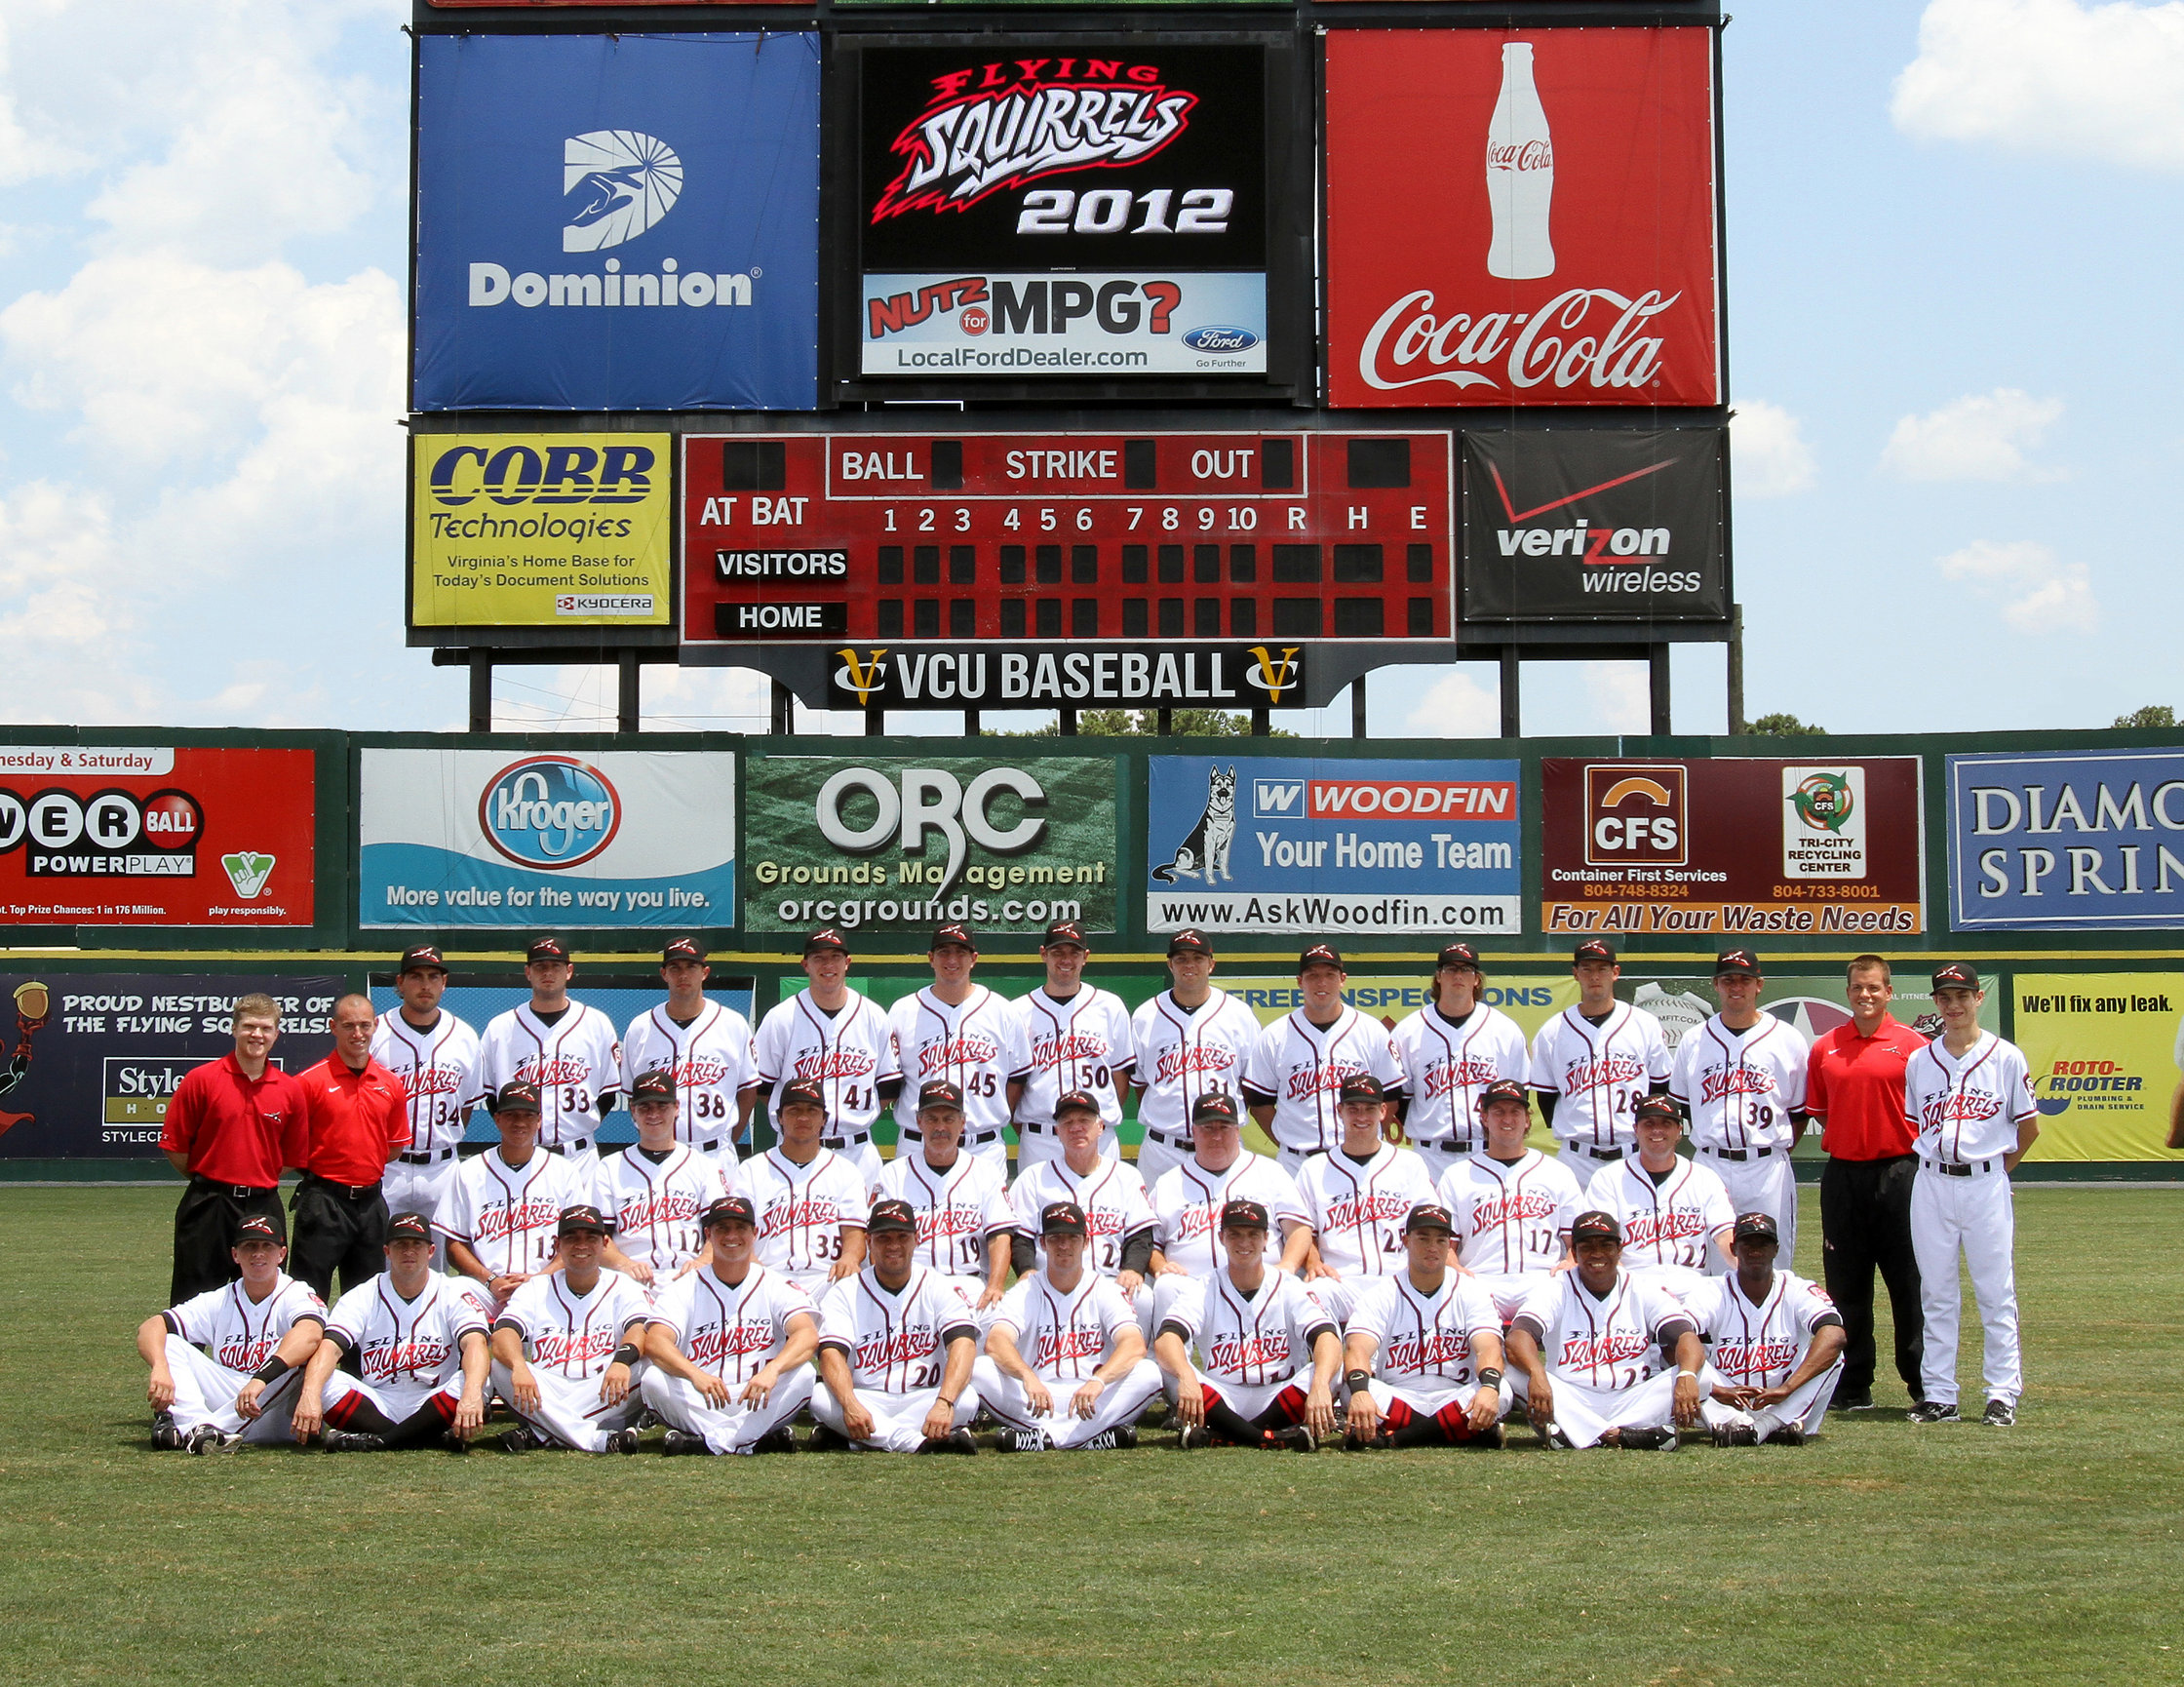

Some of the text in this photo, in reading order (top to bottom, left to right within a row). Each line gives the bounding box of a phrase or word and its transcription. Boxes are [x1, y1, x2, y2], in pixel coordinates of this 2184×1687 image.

[930, 59, 1159, 98] FLYING
[907, 89, 1187, 198] SQUIRRELS
[1488, 140, 1552, 172] Coca-Cola
[1017, 189, 1233, 234] 2012
[469, 257, 752, 307] Dominion
[867, 276, 990, 340] NUTZ
[993, 280, 1182, 334] MPG?
[963, 313, 988, 329] for
[1193, 330, 1244, 351] Ford
[1359, 289, 1682, 390] Coca-Cola
[898, 347, 1148, 368] LocalFordDealer.com
[1195, 359, 1246, 368] Go Further
[430, 446, 655, 505] COBB
[842, 451, 924, 480] BALL
[1005, 451, 1117, 478] STRIKE
[1190, 450, 1254, 478] OUT
[700, 497, 809, 526] AT BAT
[883, 506, 1427, 531] 1 2 3 4 5 6 7 8 9 10 R H E
[430, 512, 632, 543] Technologies
[1497, 519, 1670, 565] verizon
[448, 555, 636, 569] Virginia's Home Base for
[717, 552, 846, 575] VISITORS
[434, 573, 649, 590] Today's Document Solutions
[1582, 566, 1701, 593] wireless
[739, 607, 822, 628] HOME
[896, 652, 1235, 699] VCU BASEBALL
[60, 753, 72, 766] &
[78, 753, 153, 771] Saturday
[1257, 785, 1509, 813] W WOODFIN
[1814, 802, 1834, 811] CFS
[146, 811, 195, 833] BALL
[497, 771, 608, 855] Kroger
[815, 766, 1046, 900] ORC
[1594, 817, 1678, 850] CFS
[1799, 839, 1853, 847] TRI-CITY
[1255, 832, 1511, 869] Your Home Team
[1788, 850, 1861, 860] RECYCLING
[756, 862, 1106, 889] Grounds Maagement
[1551, 869, 1727, 883] Container First Services
[1799, 862, 1851, 873] CENTER
[387, 885, 710, 912] More value for the way you live.
[1583, 884, 1690, 897] 804-748-8324
[1773, 884, 1880, 897] 804-733-8001
[10, 905, 26, 917] Top
[28, 905, 51, 915] Prize
[53, 905, 95, 915] Chances:
[97, 905, 101, 915] 1
[104, 905, 113, 915] in
[115, 906, 131, 915] 176
[132, 905, 167, 915] Million.
[209, 906, 286, 917] play responsibly.
[778, 894, 1082, 928] orcgrounds.com
[1161, 898, 1504, 925] www.AskWoodfin.com
[1549, 904, 1914, 932] For All Your Waste Needs
[62, 995, 143, 1012] PROUD
[305, 995, 335, 1013] OF
[2022, 995, 2173, 1014] We'll fix any leak.
[62, 1016, 106, 1034] THE
[116, 1017, 193, 1034] FLYING
[1081, 1065, 1110, 1089] 50
[2052, 1061, 2124, 1076] ROTO-
[967, 1072, 996, 1098] 45
[2049, 1077, 2143, 1091] ROOTER
[562, 1087, 590, 1114] 33
[696, 1093, 725, 1118] 38
[842, 1084, 873, 1111] 41
[1615, 1089, 1643, 1115] 28
[436, 1101, 460, 1127] 34
[1746, 1102, 1774, 1129] 39
[679, 1229, 702, 1254] 12
[815, 1235, 843, 1261] 35
[1530, 1229, 1552, 1255] 17
[910, 1362, 941, 1388] 20
